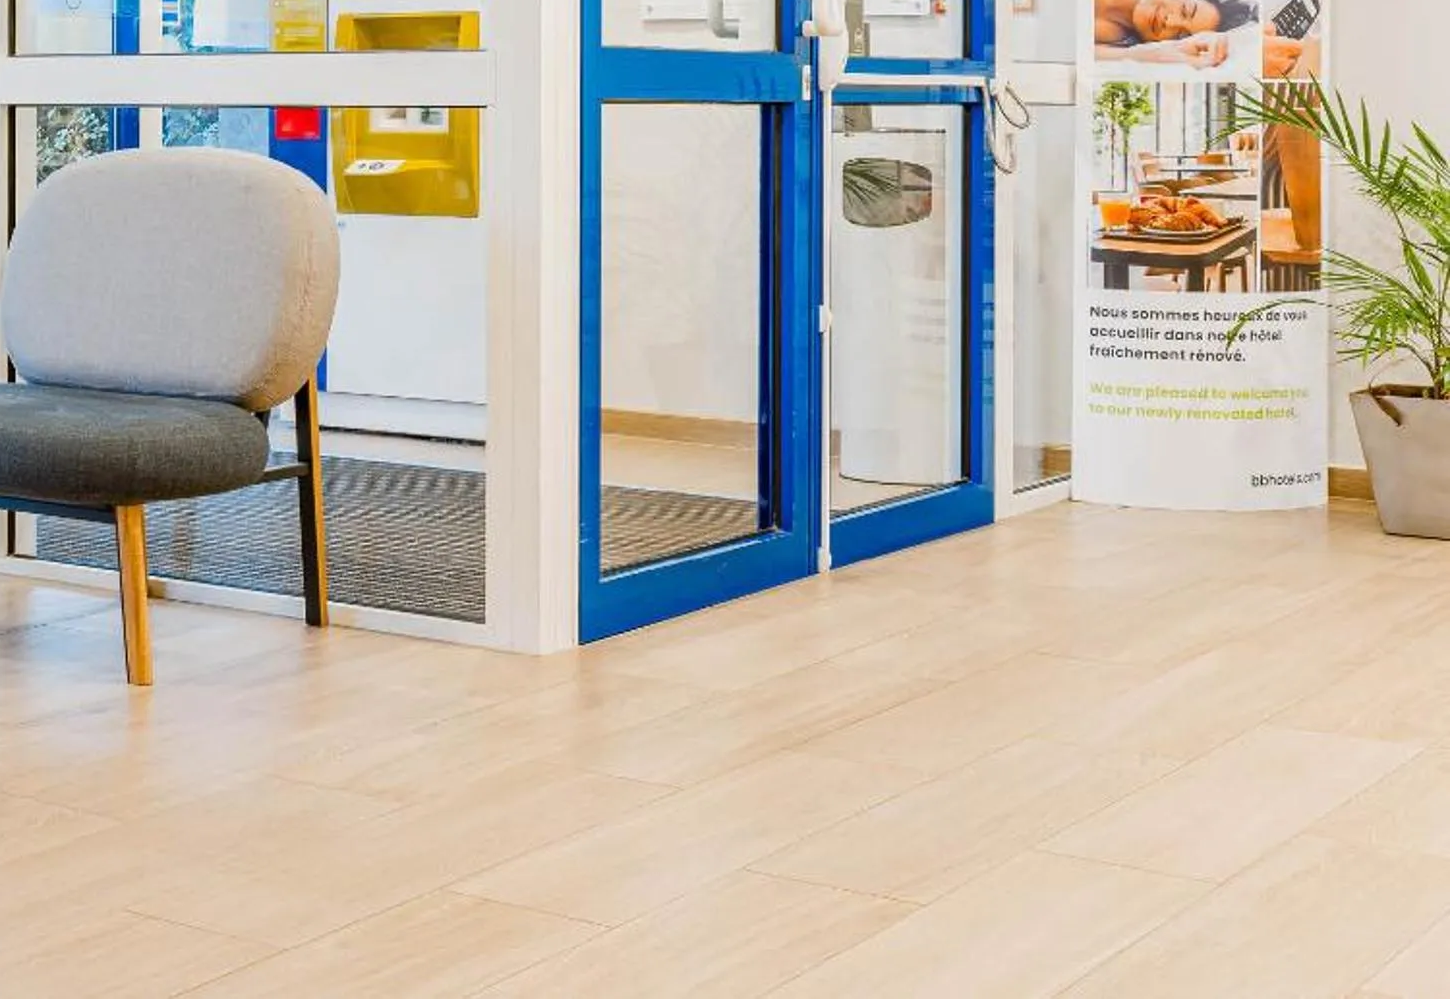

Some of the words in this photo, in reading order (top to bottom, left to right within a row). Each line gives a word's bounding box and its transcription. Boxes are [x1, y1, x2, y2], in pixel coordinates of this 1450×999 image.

[1090, 306, 1128, 319] Nous
[1132, 309, 1200, 321] sommes
[1266, 309, 1281, 321] de
[1090, 327, 1161, 341] accueillir
[1164, 329, 1204, 341] dans
[1208, 331, 1247, 342] noe
[1090, 343, 1186, 361] fraîchement
[1190, 348, 1246, 362] rénové.
